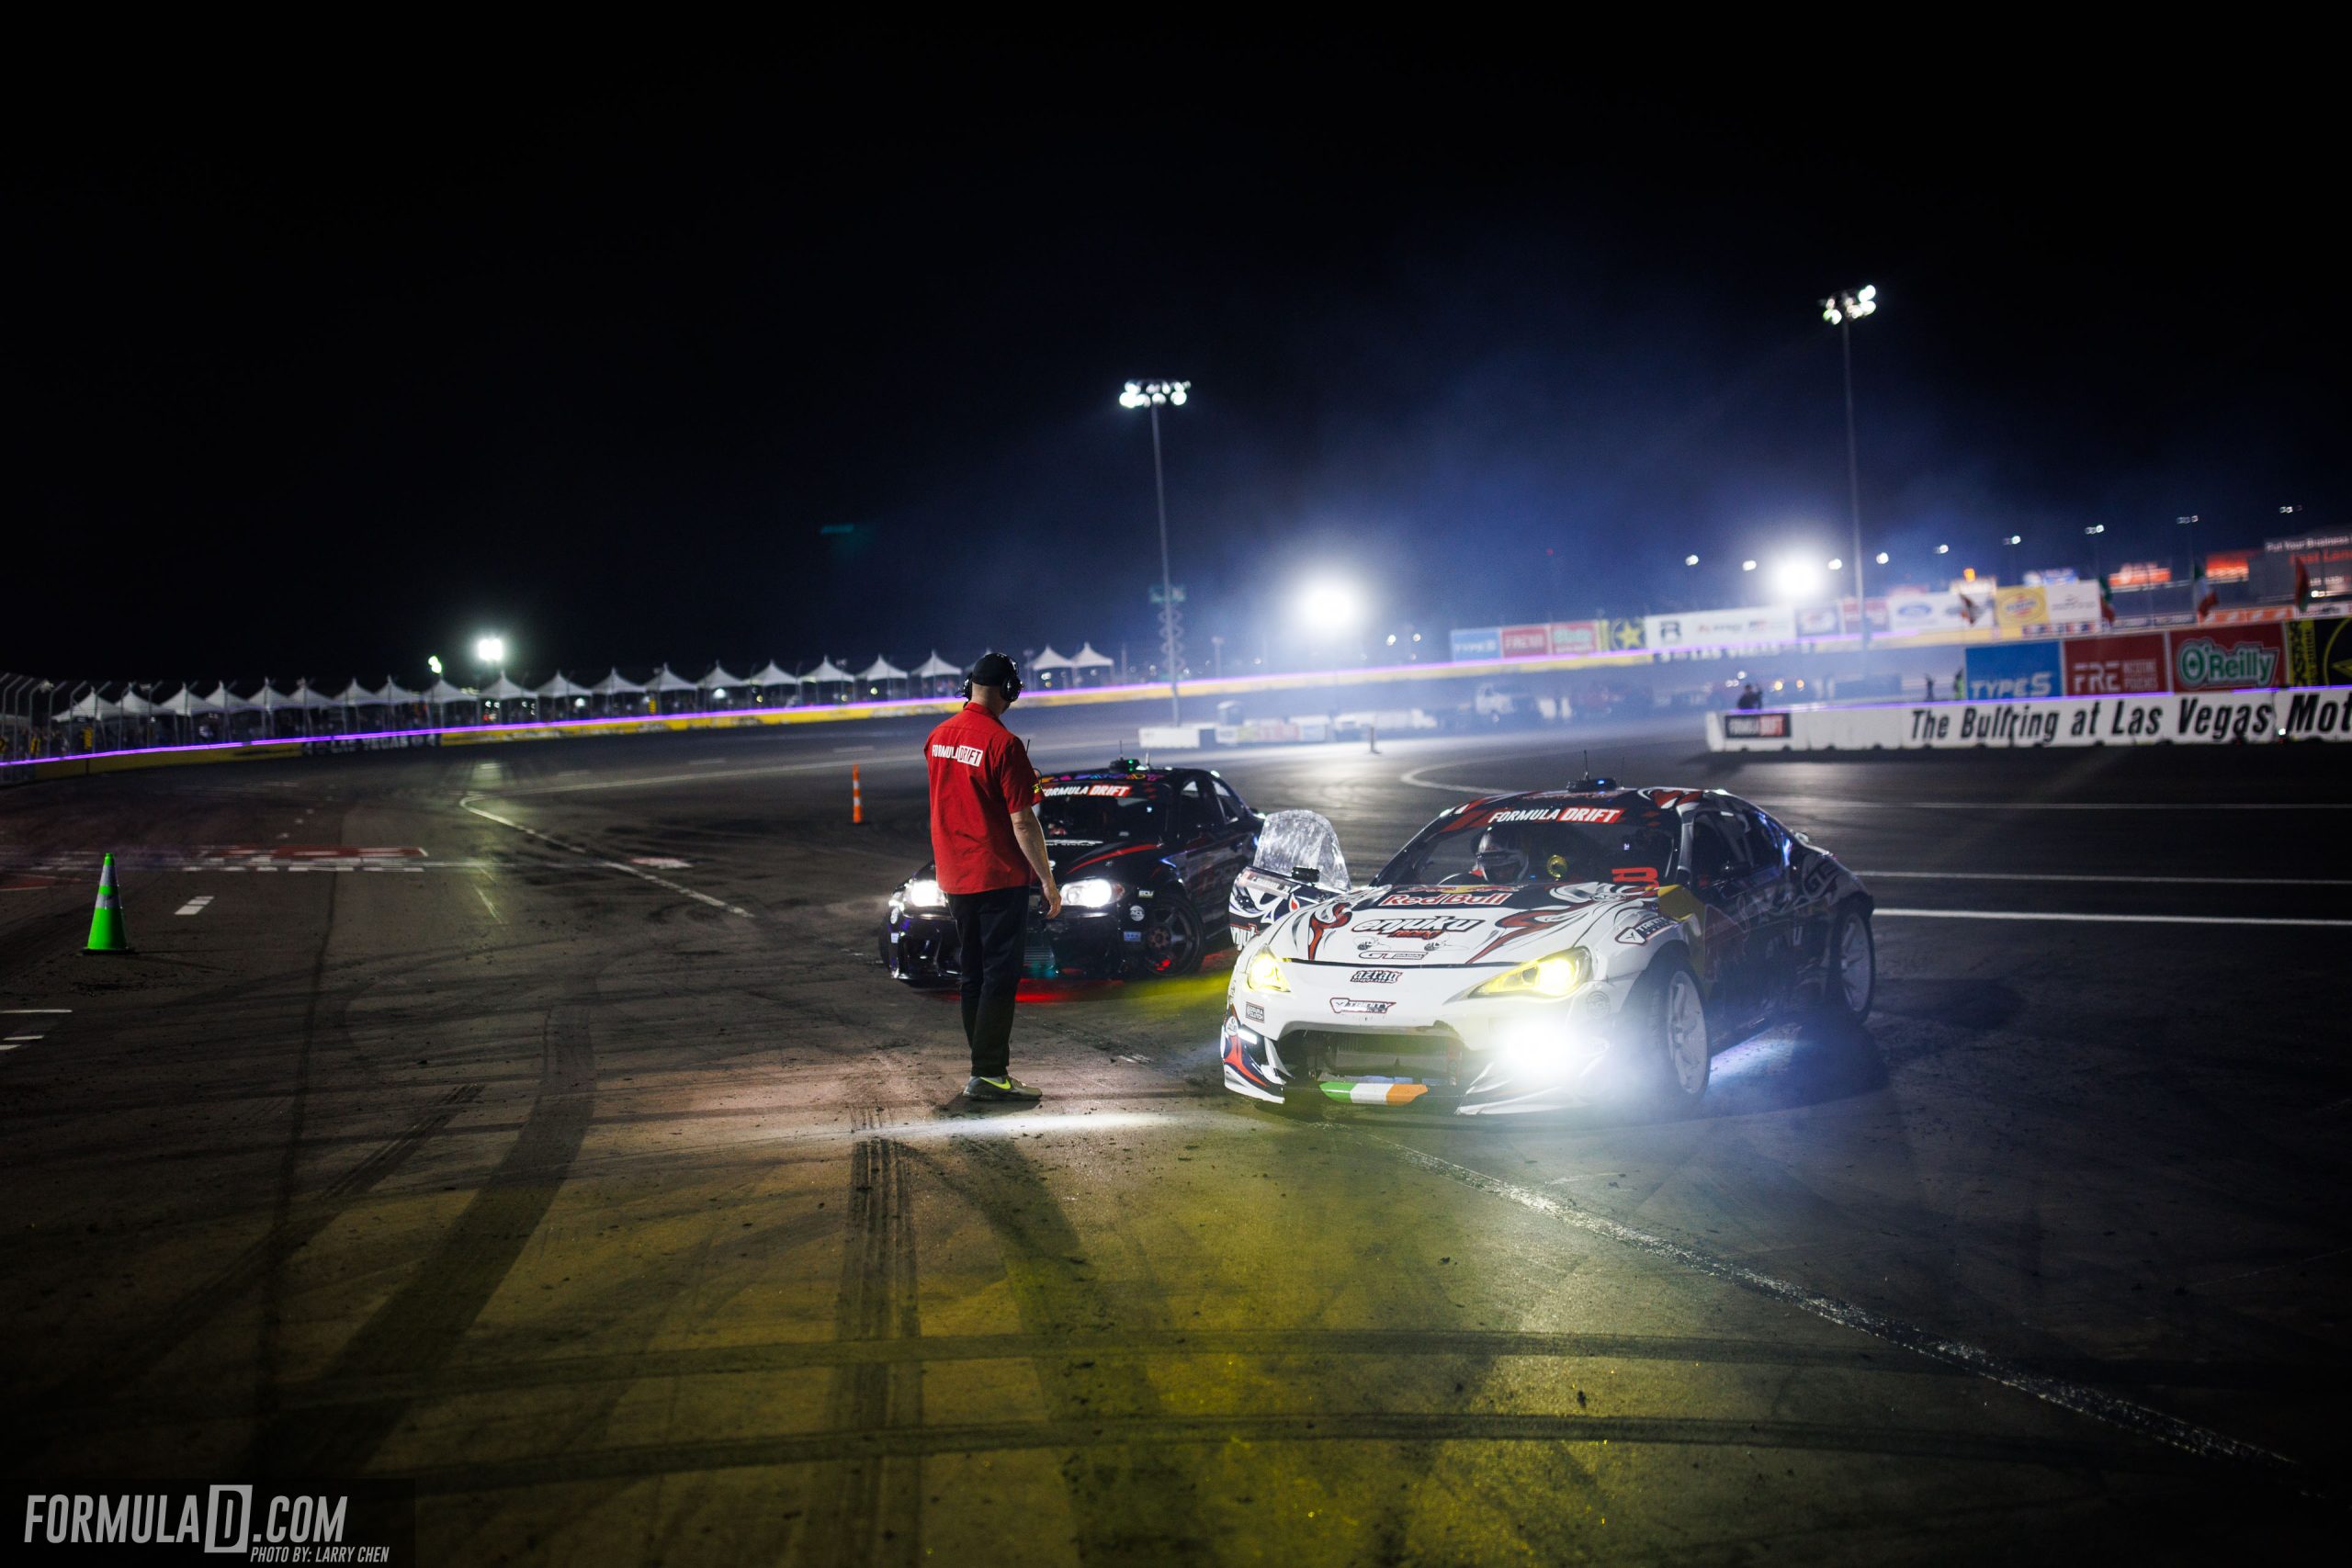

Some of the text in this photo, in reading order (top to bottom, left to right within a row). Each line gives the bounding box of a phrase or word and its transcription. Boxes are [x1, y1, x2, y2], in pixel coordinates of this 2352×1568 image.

[2182, 646, 2273, 682] O'Reilly
[1911, 710, 1950, 739] The
[2071, 702, 2100, 736] at
[2110, 700, 2163, 735] Las
[2178, 696, 2273, 739] Vegas
[959, 746, 982, 766] DRIFT
[1090, 784, 1131, 797] DRIFT
[1487, 807, 1621, 823] FORMULA DRIFT
[1378, 893, 1514, 906] Red Bull
